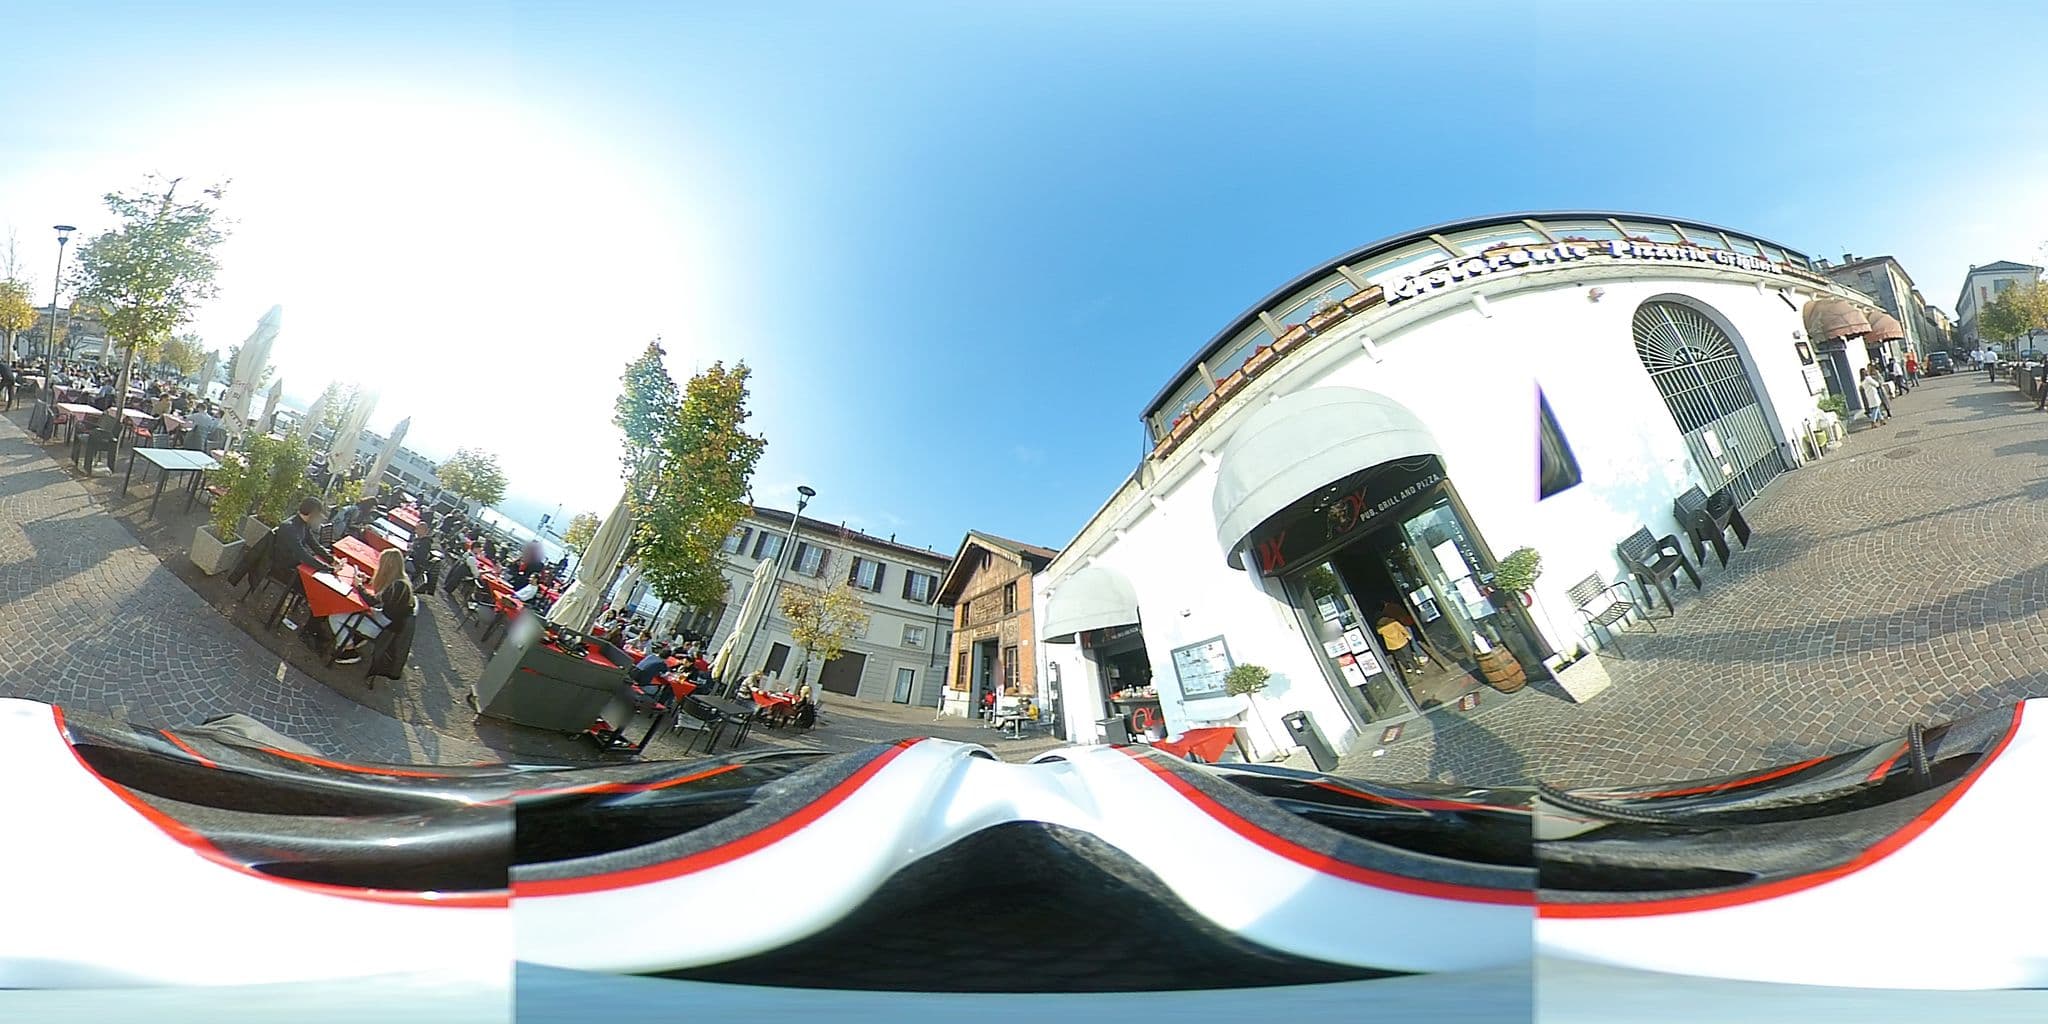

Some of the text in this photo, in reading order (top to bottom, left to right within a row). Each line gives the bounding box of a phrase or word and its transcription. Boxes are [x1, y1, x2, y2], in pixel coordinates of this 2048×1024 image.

[1378, 495, 1400, 511] GRILL
[1400, 486, 1416, 500] AND
[1416, 473, 1440, 490] PIZZA
